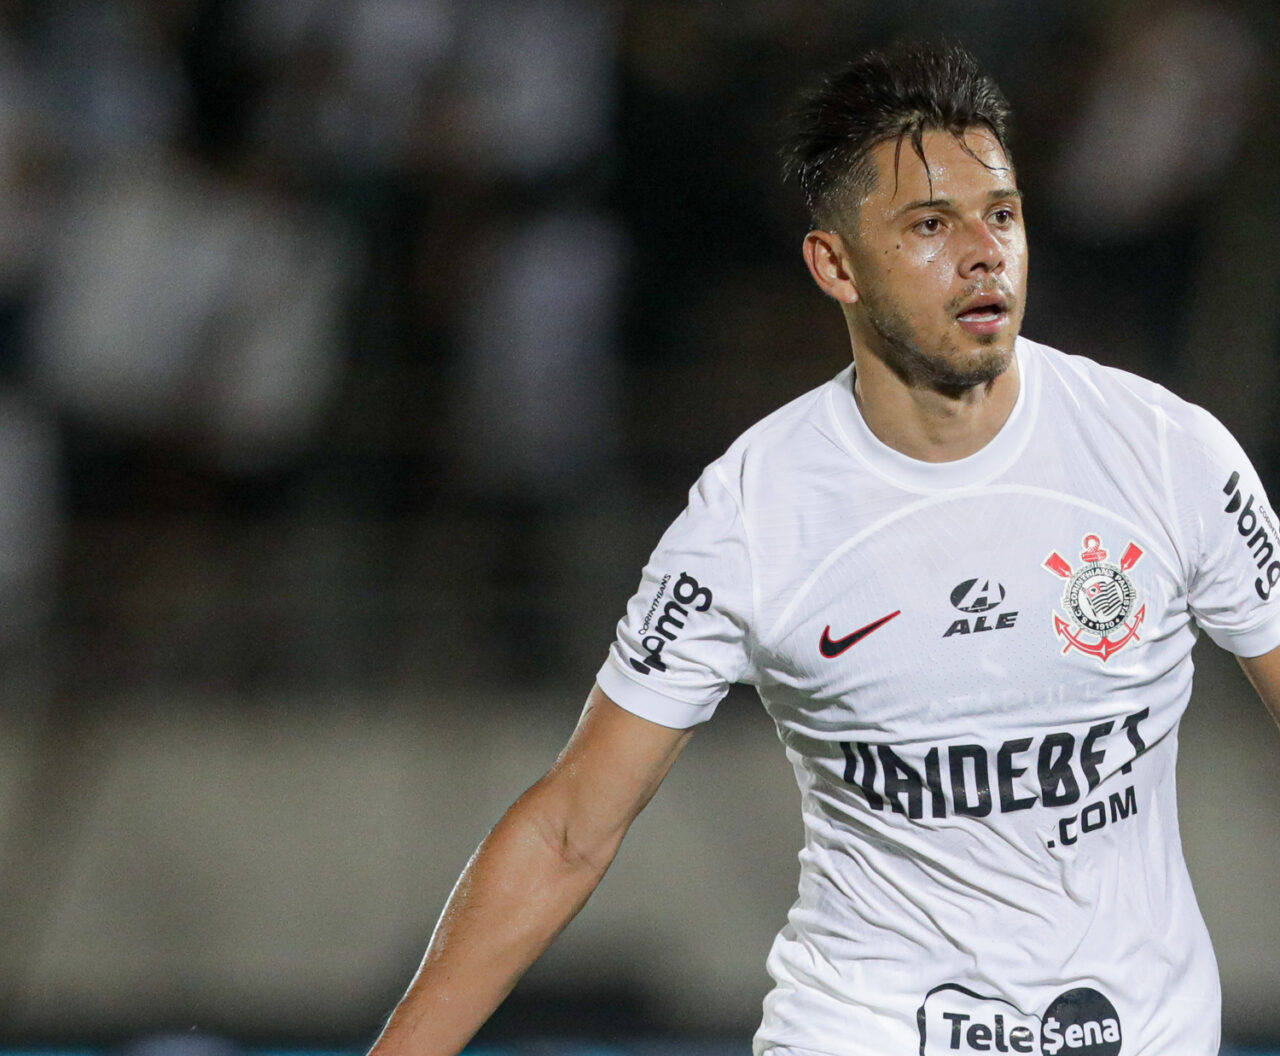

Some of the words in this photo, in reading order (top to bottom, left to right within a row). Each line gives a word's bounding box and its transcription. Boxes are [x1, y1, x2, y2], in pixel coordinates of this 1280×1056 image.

[638, 573, 672, 636] CORINTHIANS
[1071, 567, 1115, 607] CORINTHIANS
[943, 611, 1019, 638] ALE
[1047, 785, 1138, 848] .COM
[943, 1012, 1035, 1053] Tele
